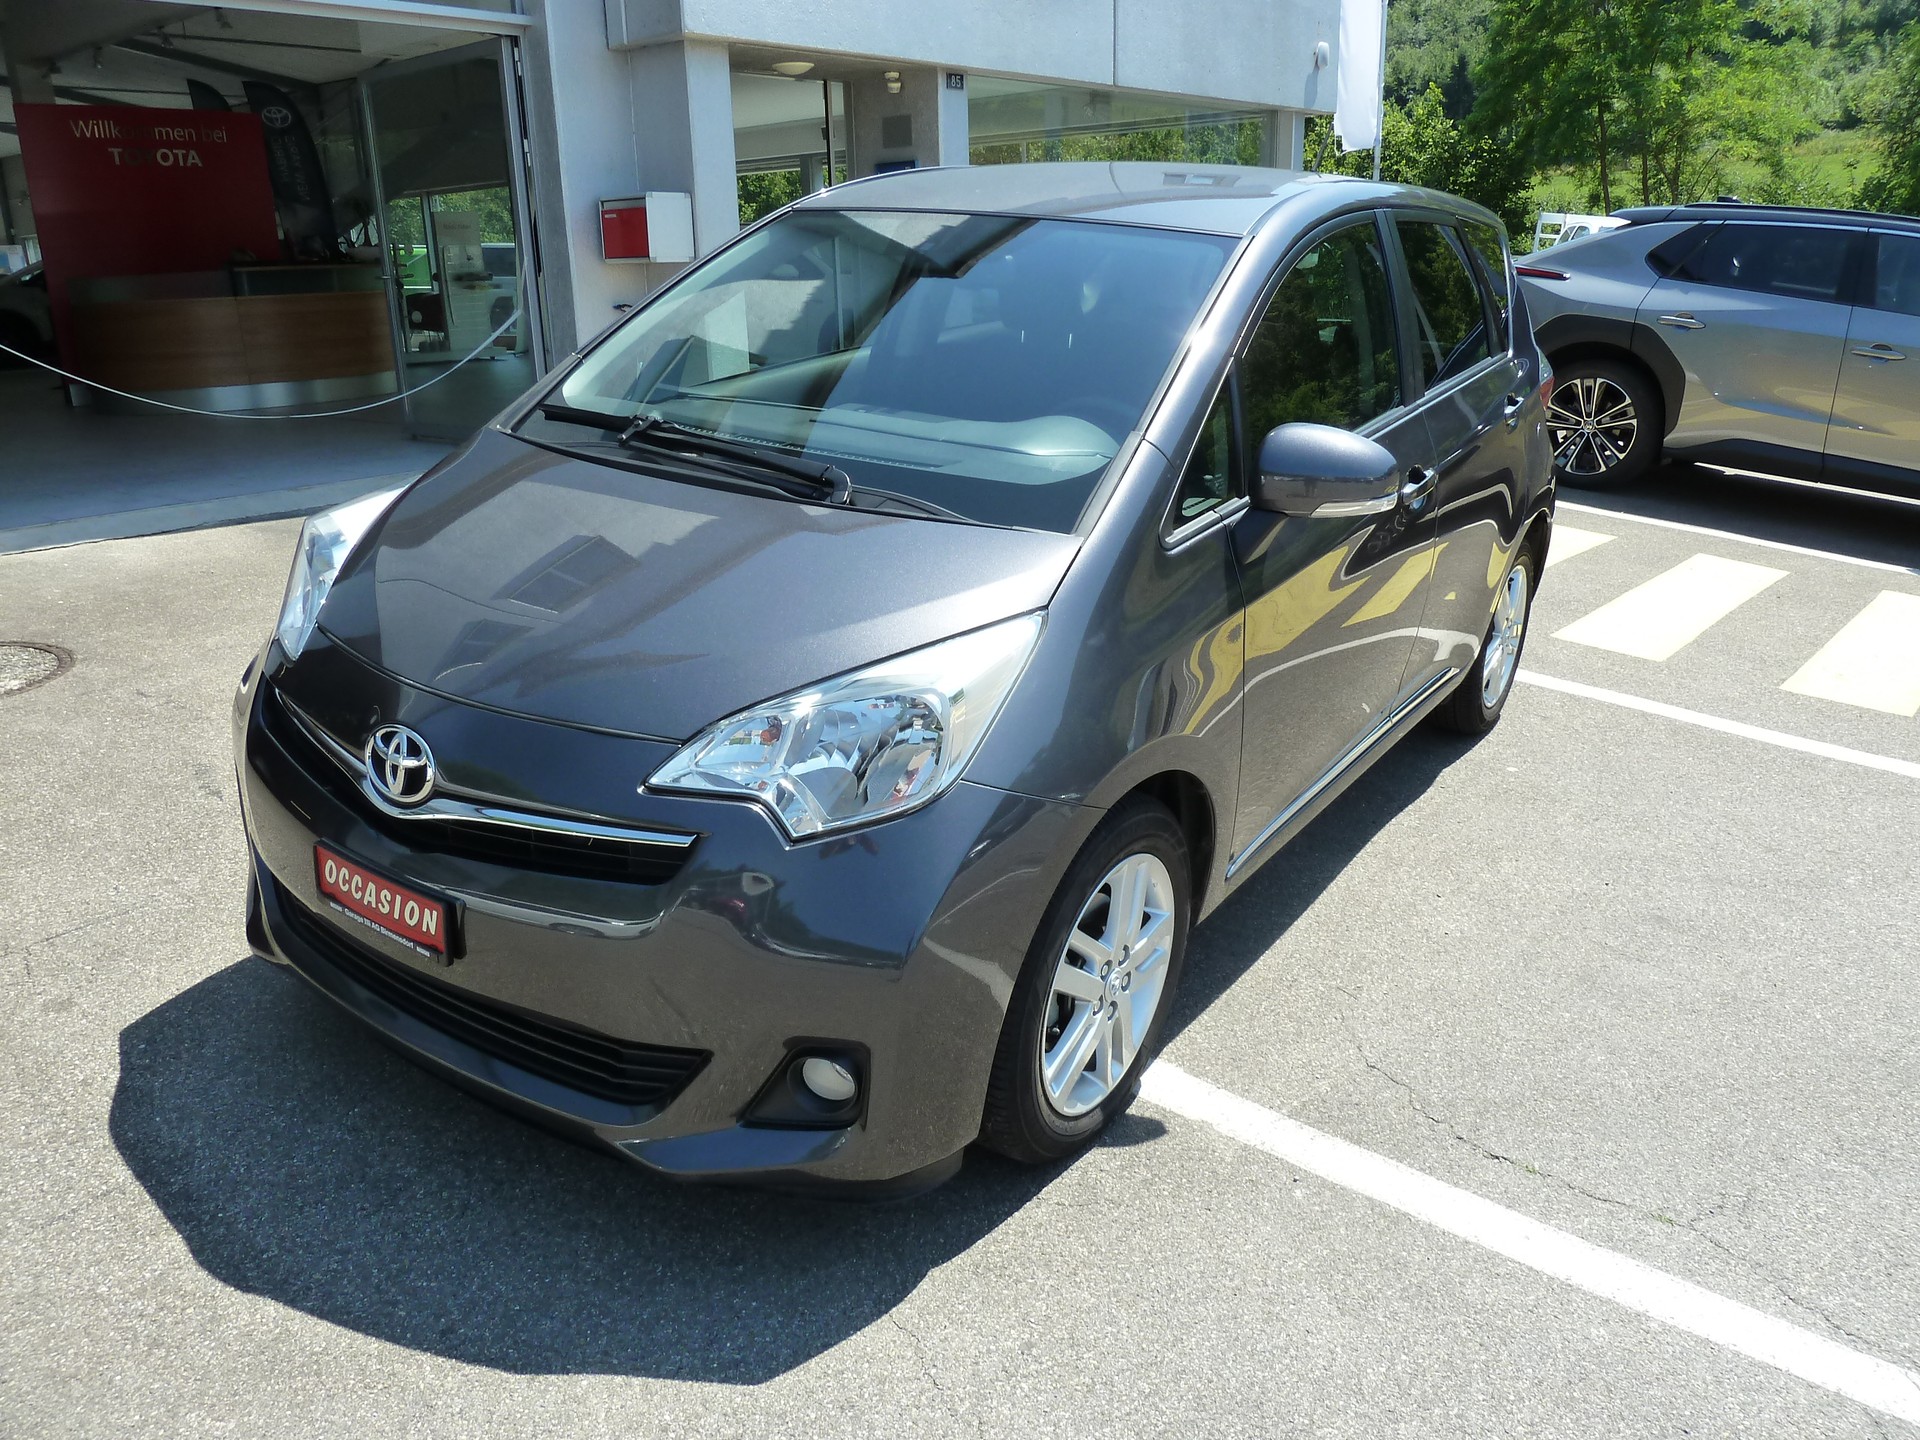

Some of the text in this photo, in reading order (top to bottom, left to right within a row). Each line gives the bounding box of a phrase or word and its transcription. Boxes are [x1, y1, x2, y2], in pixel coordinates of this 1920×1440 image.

[951, 75, 961, 87] 85
[69, 119, 227, 143] Willkommen bei
[107, 147, 203, 168] TOYOTA
[325, 859, 437, 935] OCCASION
